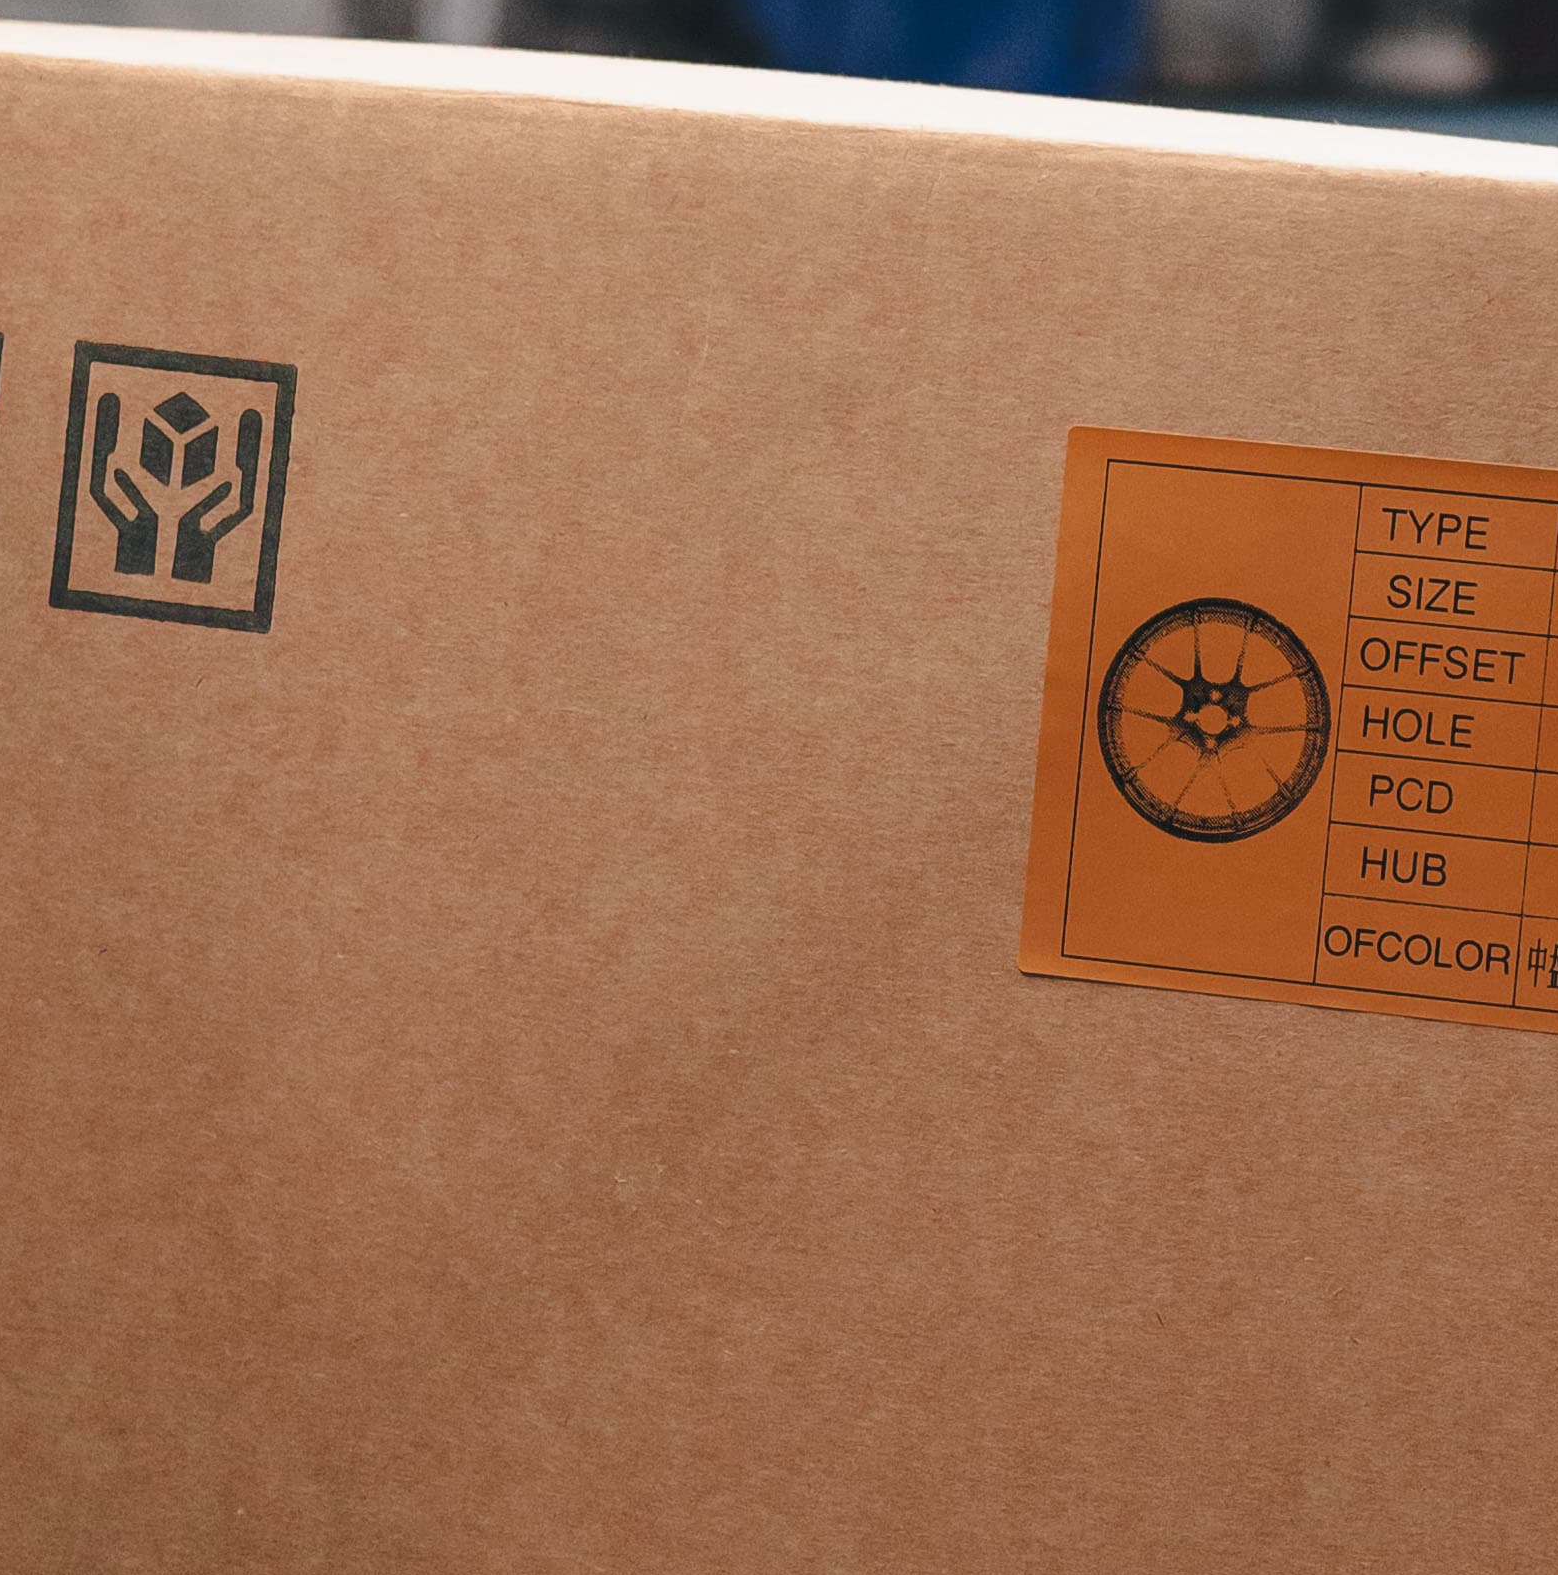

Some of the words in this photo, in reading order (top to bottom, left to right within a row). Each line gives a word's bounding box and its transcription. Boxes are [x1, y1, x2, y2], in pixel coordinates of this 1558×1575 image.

[1381, 507, 1490, 551] TYPE
[1386, 574, 1478, 616] SIZE
[1359, 637, 1526, 685] OFFSET
[1362, 704, 1475, 749] HOLE
[1369, 773, 1454, 815] PCD
[1360, 845, 1447, 887] HUB
[1324, 924, 1511, 976] OFCOLOR
